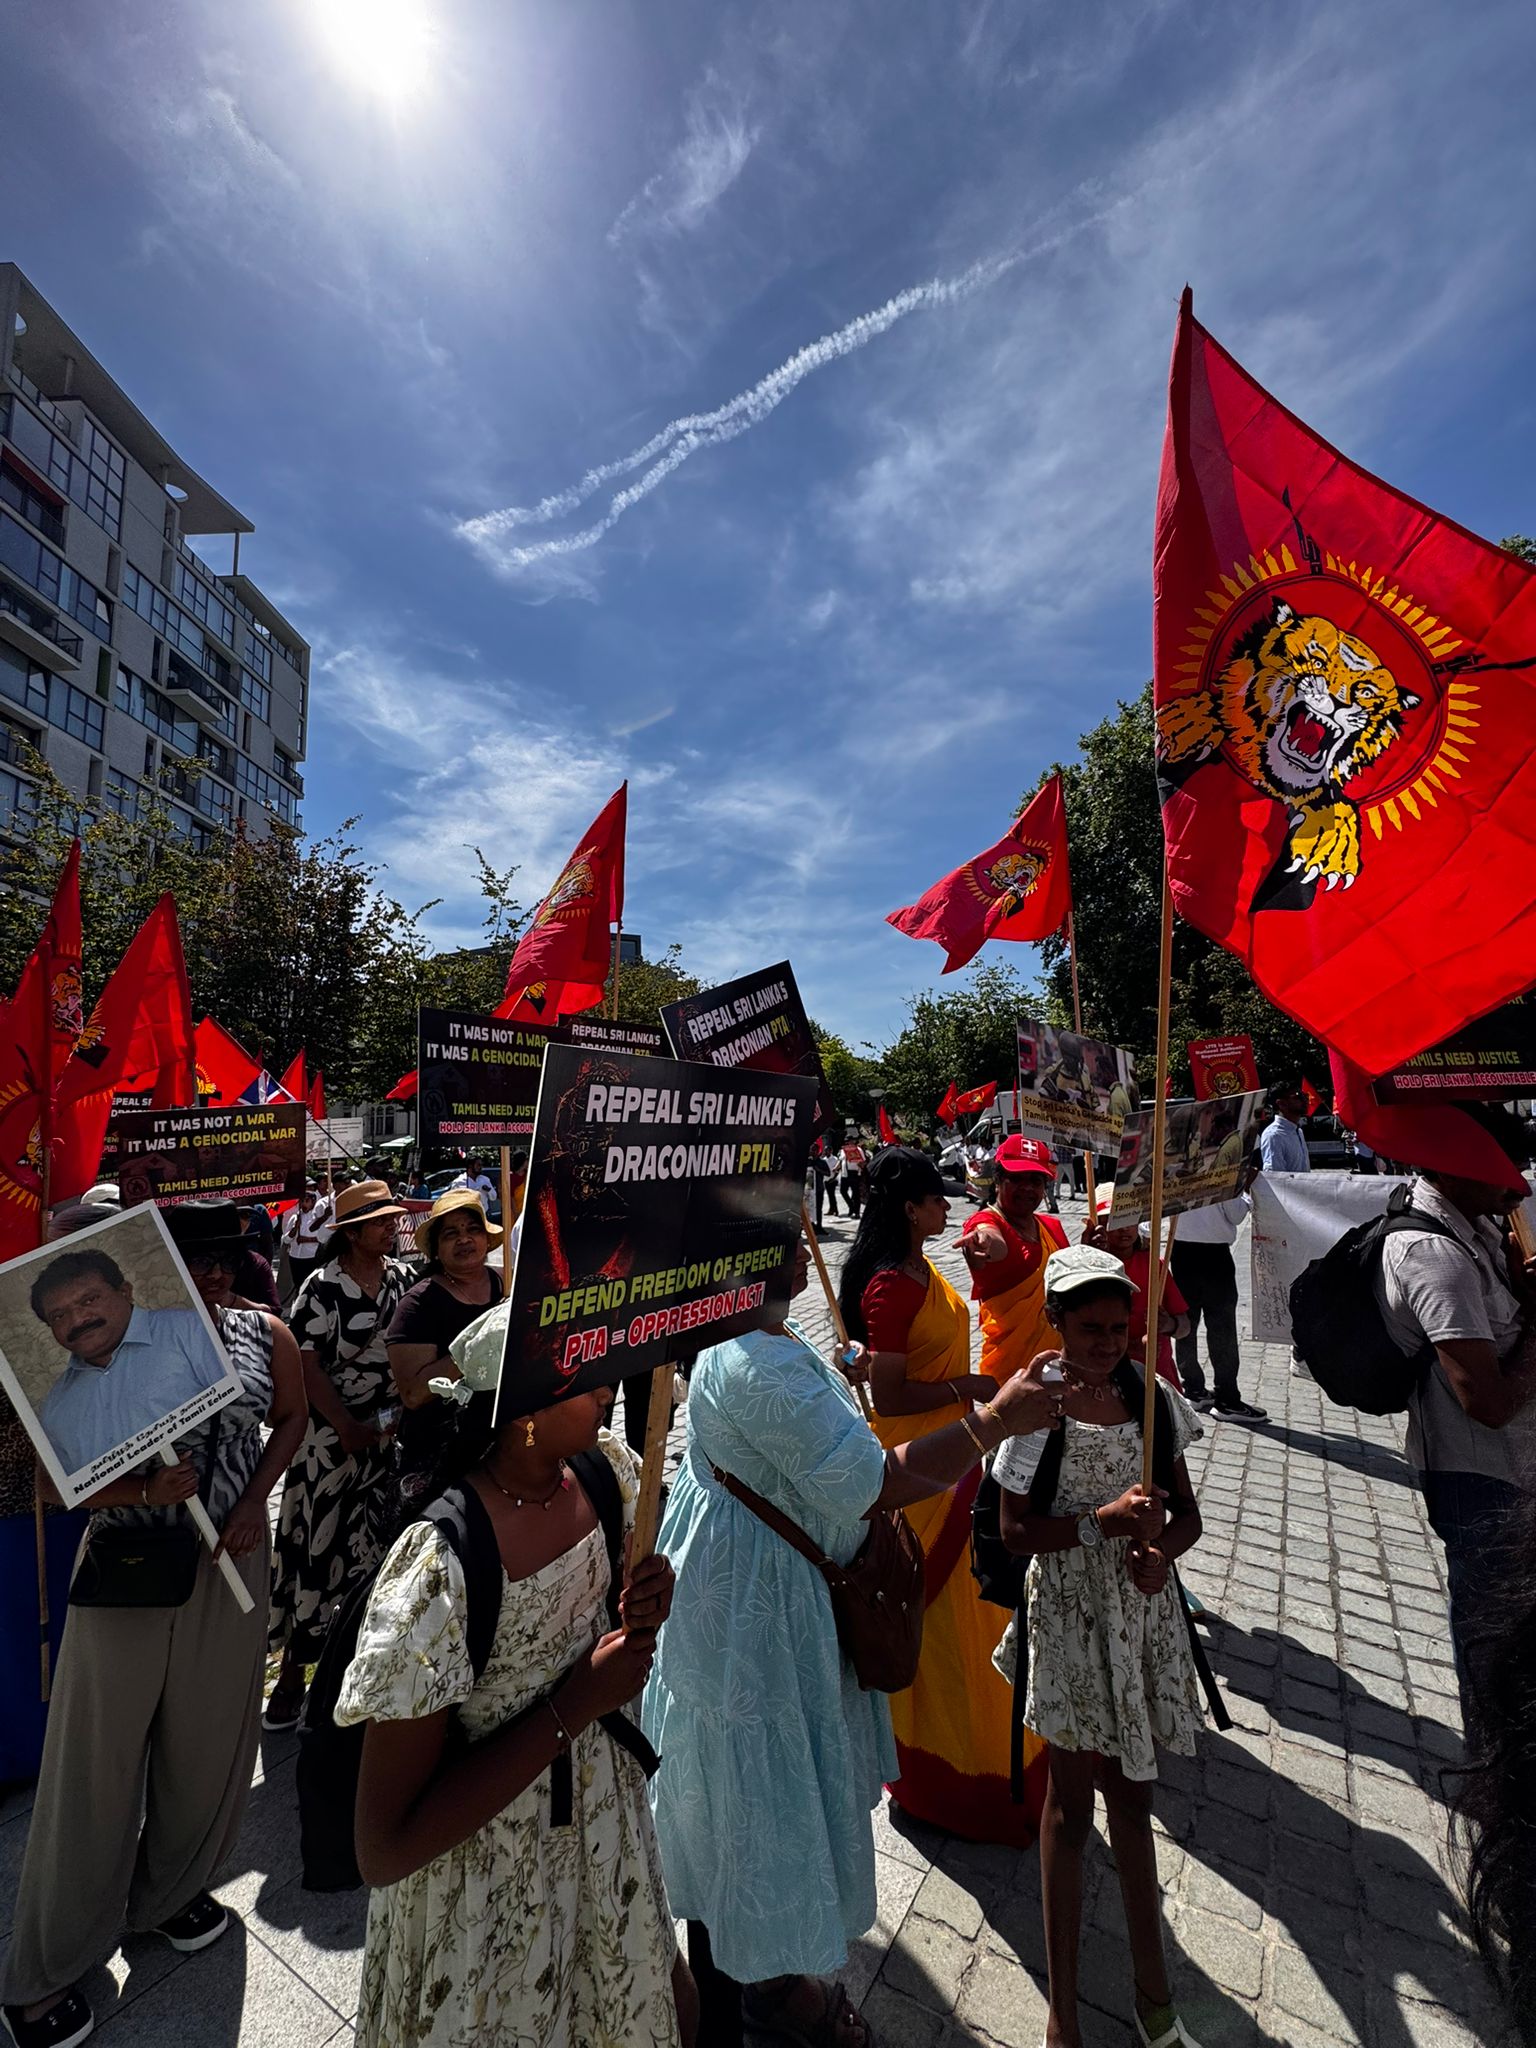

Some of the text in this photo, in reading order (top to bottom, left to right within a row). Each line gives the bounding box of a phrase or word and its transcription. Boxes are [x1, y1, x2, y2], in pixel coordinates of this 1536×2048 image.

[687, 980, 789, 1044] REPEAL SRI LANKA'S
[450, 1023, 461, 1038] IT
[463, 1025, 489, 1041] WAS
[491, 1028, 514, 1044] NOT
[516, 1032, 524, 1045] A
[572, 1024, 661, 1046] REPEAL SRI LANKA'S
[711, 1015, 791, 1067] DRACONIAN PTA!
[427, 1043, 542, 1067] IT WAS A GENOCIDAL
[1444, 1052, 1475, 1066] NEED
[1393, 1074, 1422, 1089] HOLD
[1422, 1073, 1441, 1088] SRI
[1442, 1072, 1474, 1088] LANKA
[452, 1103, 487, 1116] TAMILS
[488, 1104, 513, 1116] NEED
[585, 1084, 797, 1127] REPEAL SRI LANKA'S
[1024, 1096, 1042, 1109] Stop
[154, 1120, 168, 1133] IT
[171, 1118, 201, 1131] WAS
[204, 1116, 232, 1129] NOT
[235, 1115, 243, 1126] A
[1024, 1109, 1050, 1122] Tamils
[439, 1121, 462, 1134] HOLD
[463, 1121, 479, 1134] SRI
[480, 1121, 506, 1134] LANKA
[128, 1140, 142, 1153] IT
[146, 1137, 176, 1151] WAS
[179, 1136, 189, 1149] A
[192, 1129, 266, 1147] GENOCIDAL
[604, 1143, 776, 1184] DRACONIAN PTA!
[158, 1171, 273, 1194] TAMILS NEED JUSTICE
[539, 1245, 786, 1328] DEFEND FREEDOM OF SPEECH!
[563, 1326, 608, 1369] PTA
[611, 1329, 626, 1346] =
[627, 1289, 736, 1348] OPPRESSION
[73, 1385, 236, 1495] National Leader of Tamil Eelam
